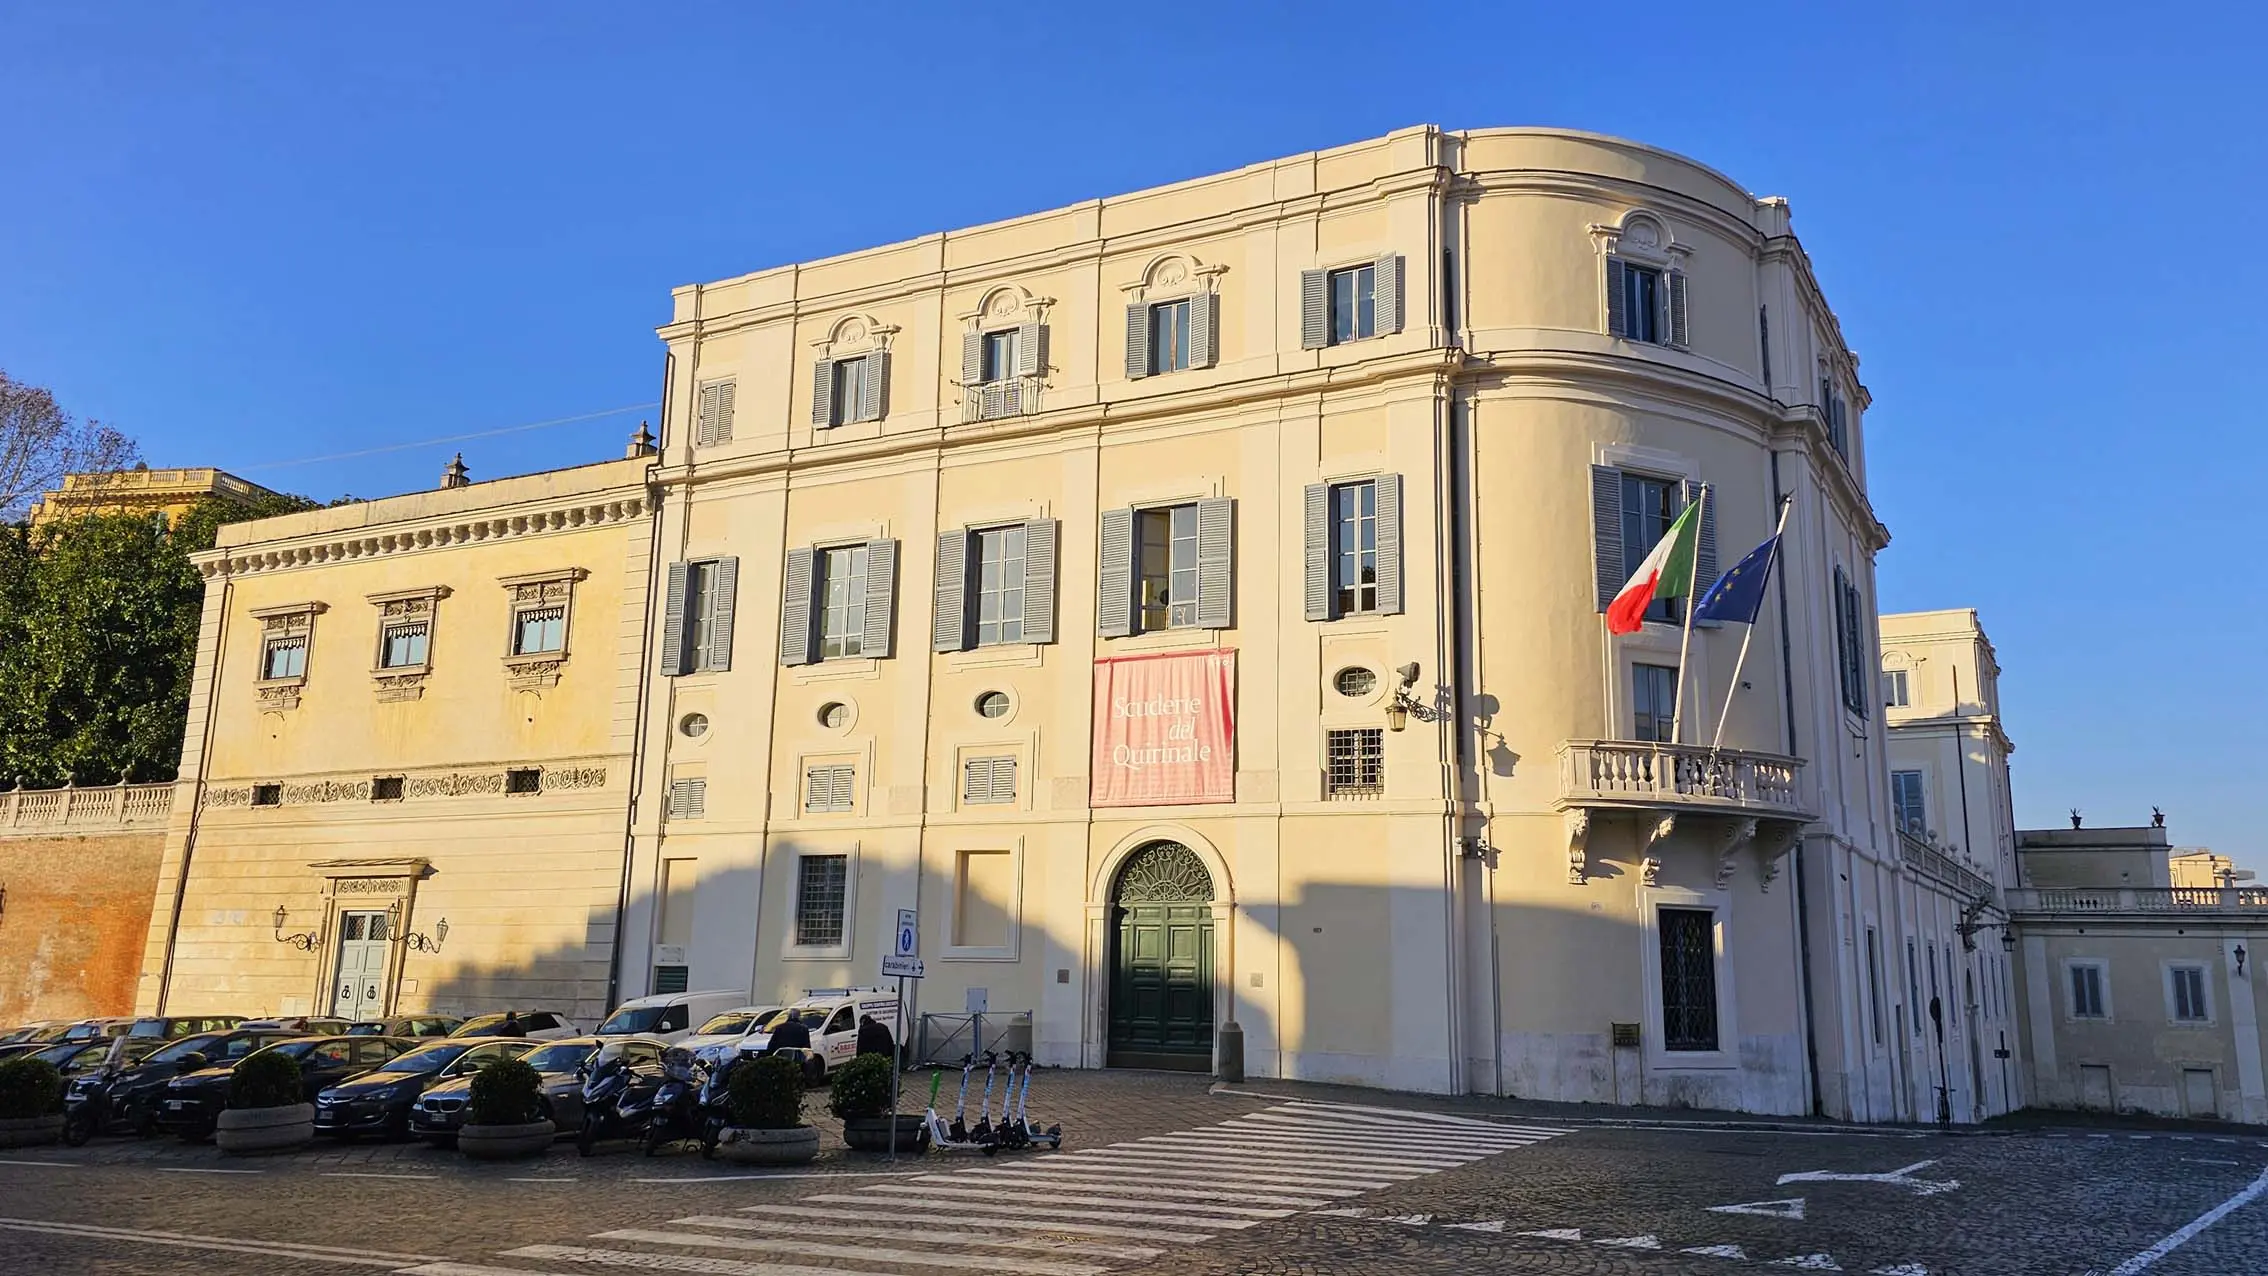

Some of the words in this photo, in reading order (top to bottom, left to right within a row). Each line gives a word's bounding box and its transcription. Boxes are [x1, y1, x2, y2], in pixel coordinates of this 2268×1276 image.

[1114, 693, 1201, 718] Scuderie
[1168, 717, 1195, 740] del
[1113, 739, 1211, 770] Quirinale
